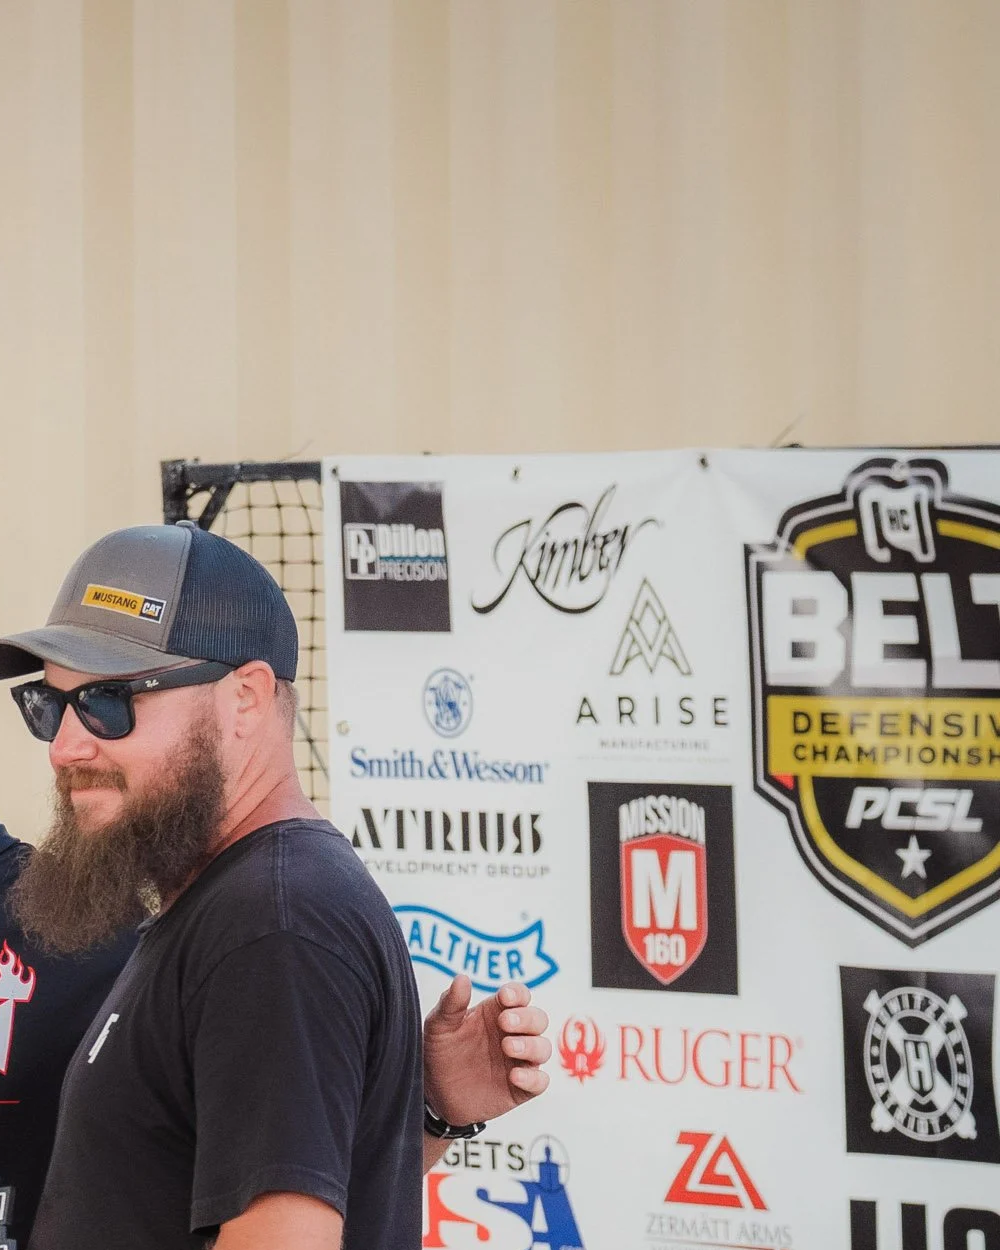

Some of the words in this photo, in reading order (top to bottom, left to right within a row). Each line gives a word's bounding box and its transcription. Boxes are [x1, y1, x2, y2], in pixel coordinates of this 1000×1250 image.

[377, 523, 446, 557] Dillon
[378, 561, 448, 581] PRECISION
[92, 591, 138, 611] MUSTANG
[141, 602, 163, 617] CAT
[576, 696, 729, 726] ARISE
[618, 794, 706, 844] MISSION
[845, 786, 984, 833] PCSL
[352, 807, 542, 854] ATRIUS
[487, 864, 551, 880] GROUP
[631, 848, 698, 931] M
[408, 920, 526, 980] ALTHER
[643, 932, 687, 966] 160
[618, 1024, 805, 1094] RUGER
[737, 1221, 793, 1246] ARMS
